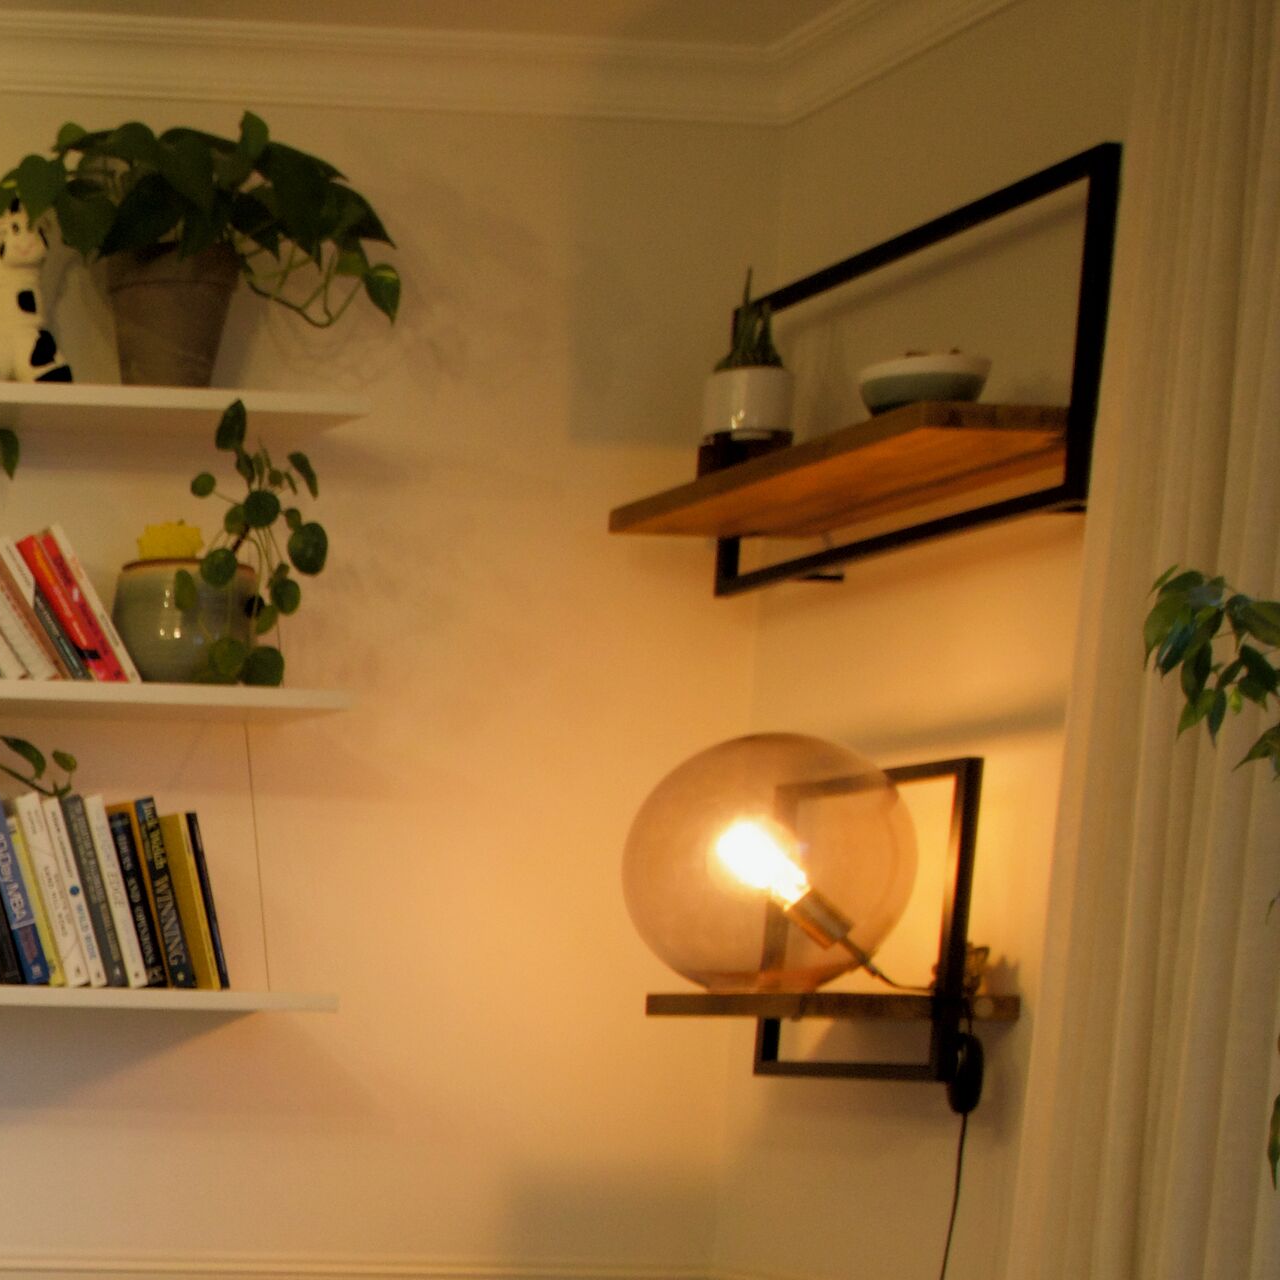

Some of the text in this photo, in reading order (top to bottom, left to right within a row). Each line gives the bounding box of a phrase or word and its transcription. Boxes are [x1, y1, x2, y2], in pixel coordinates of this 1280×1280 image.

[145, 801, 157, 829] Jack
[151, 830, 167, 869] Welch
[8, 882, 27, 920] MBA
[76, 904, 88, 932] WILD
[154, 873, 187, 965] WINNING
